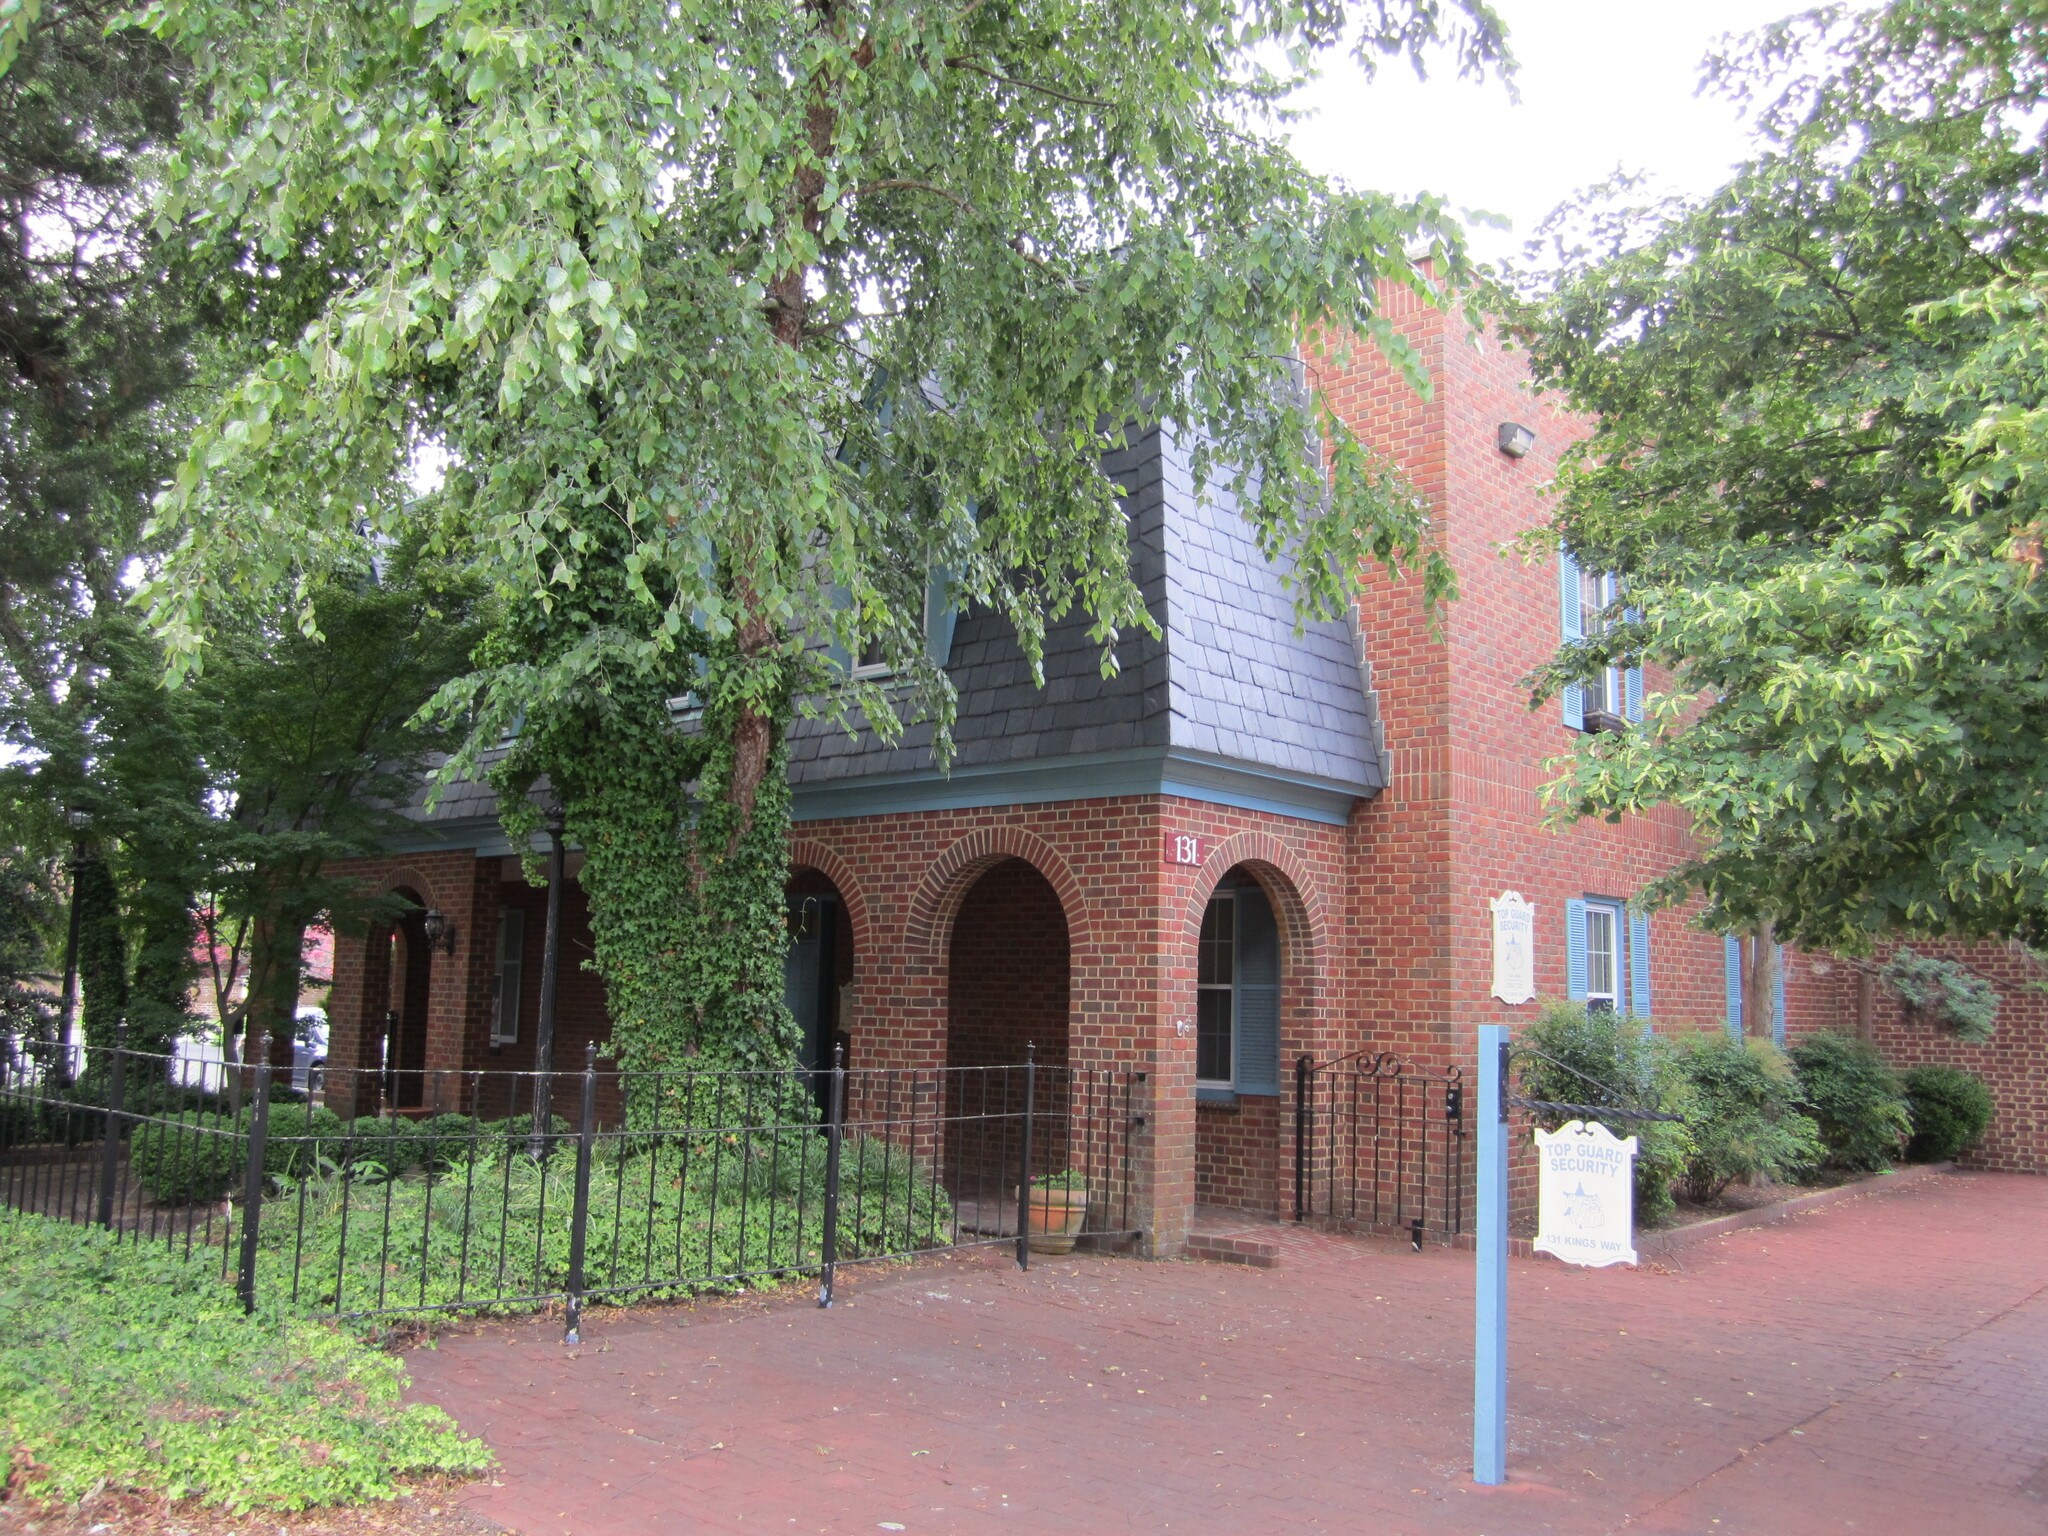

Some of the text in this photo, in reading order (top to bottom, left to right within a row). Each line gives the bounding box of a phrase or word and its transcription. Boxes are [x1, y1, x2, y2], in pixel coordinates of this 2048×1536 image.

[1174, 835, 1197, 864] 131
[1497, 907, 1531, 923] TOP GUARD
[1499, 920, 1529, 933] SECURITY
[1545, 1143, 1624, 1164] TOP GUARD
[1550, 1158, 1618, 1177] SECURITY
[1546, 1234, 1622, 1252] 131 KINGS WAY
